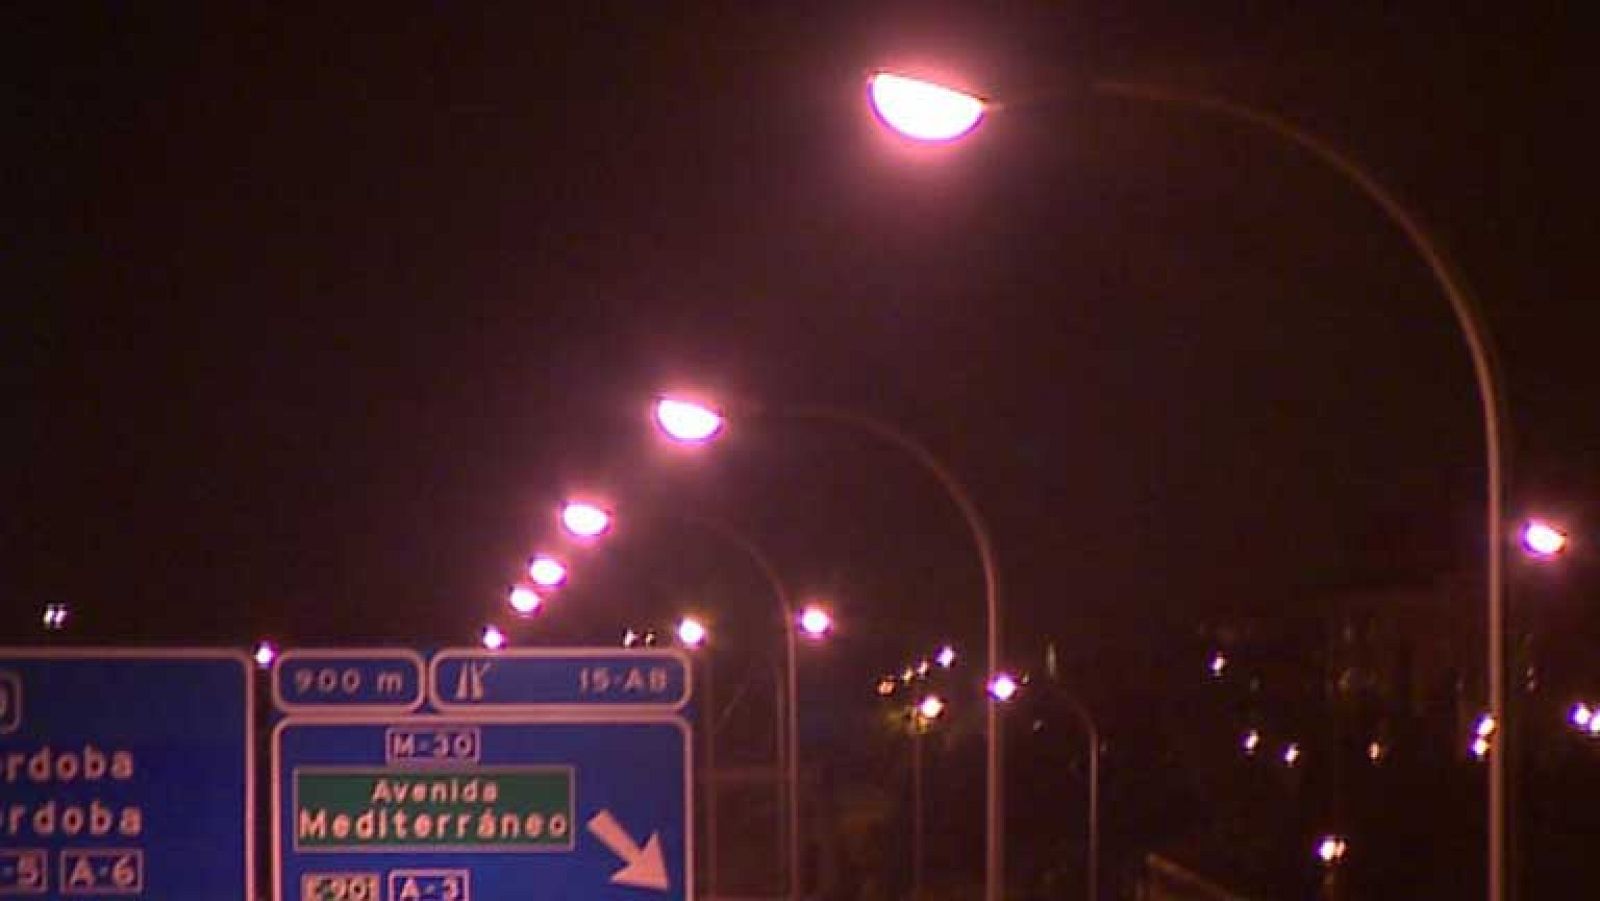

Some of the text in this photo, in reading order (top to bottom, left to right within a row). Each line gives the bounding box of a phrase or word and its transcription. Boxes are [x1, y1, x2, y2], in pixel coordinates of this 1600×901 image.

[295, 667, 402, 693] 900 m
[393, 732, 472, 758] M-30
[0, 744, 134, 782] rdoba
[372, 779, 498, 802] Avenida
[0, 800, 142, 835] rdoba
[299, 807, 567, 839] Mediterráneo
[70, 855, 135, 887] A-6
[399, 877, 459, 901] A-3
